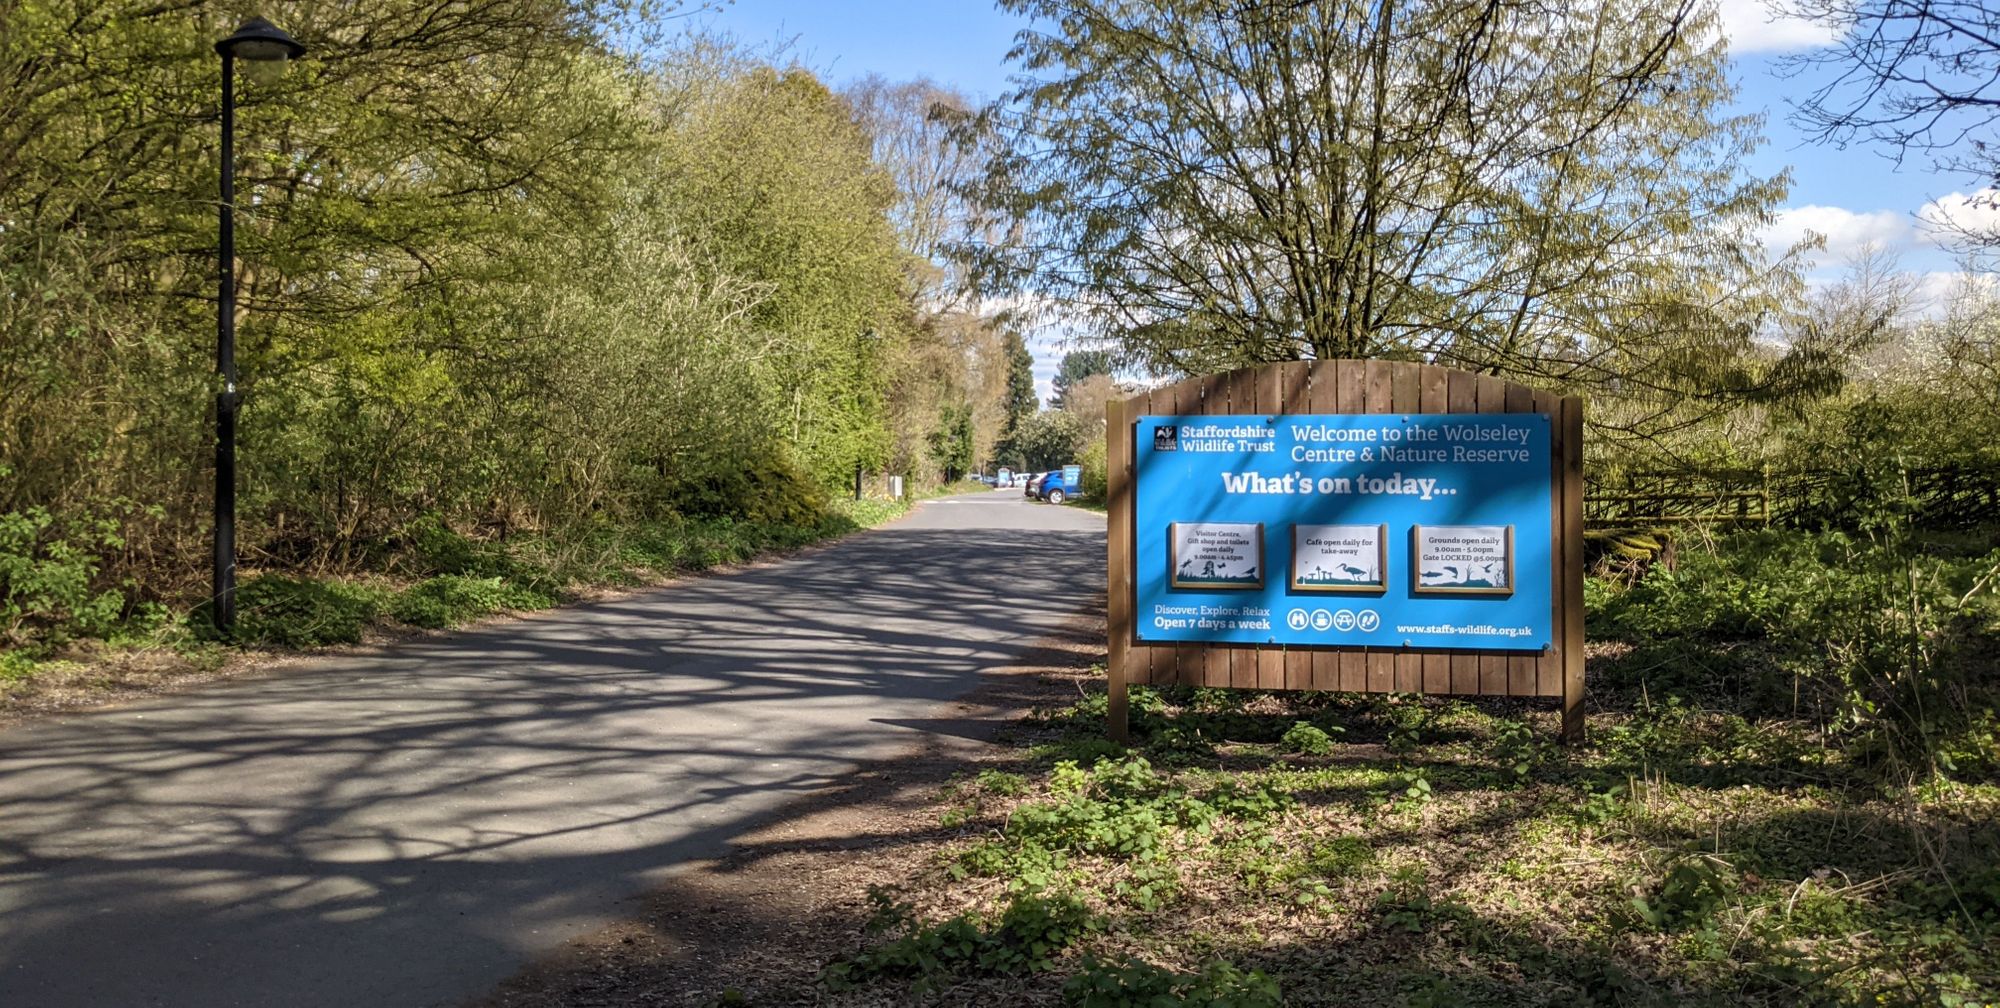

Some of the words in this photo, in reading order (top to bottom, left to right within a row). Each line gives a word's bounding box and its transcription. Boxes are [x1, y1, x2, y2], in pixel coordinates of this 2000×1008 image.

[1181, 425, 1276, 438] Staffordshire
[1291, 425, 1377, 442] Welcome
[1382, 427, 1401, 442] to
[1406, 424, 1438, 442] the
[1443, 424, 1531, 445] Wolseley
[1181, 440, 1235, 452] Wildlife
[1237, 440, 1275, 452] Trust
[1291, 445, 1356, 462] Centre
[1360, 446, 1375, 462] &
[1380, 445, 1447, 462] Nature
[1452, 445, 1530, 462] Reserve
[1221, 471, 1314, 495] What's
[1318, 478, 1352, 495] on
[1356, 472, 1457, 500] today...
[1200, 538, 1215, 546] shop
[1342, 538, 1361, 547] daily
[1361, 538, 1373, 546] for
[1428, 536, 1460, 544] Grounds
[1481, 537, 1500, 545] daily
[1218, 545, 1235, 554] daily
[1321, 548, 1358, 556] take-away
[1154, 604, 1199, 616] Discover,
[1200, 605, 1240, 617] Explore,
[1242, 606, 1270, 617] Relax
[1154, 617, 1186, 630] Open
[1188, 618, 1196, 628] 7
[1197, 617, 1226, 631] days
[1228, 620, 1236, 629] a
[1237, 618, 1271, 630] week
[1397, 623, 1533, 638] www.staffs-wildlife.org.uk
